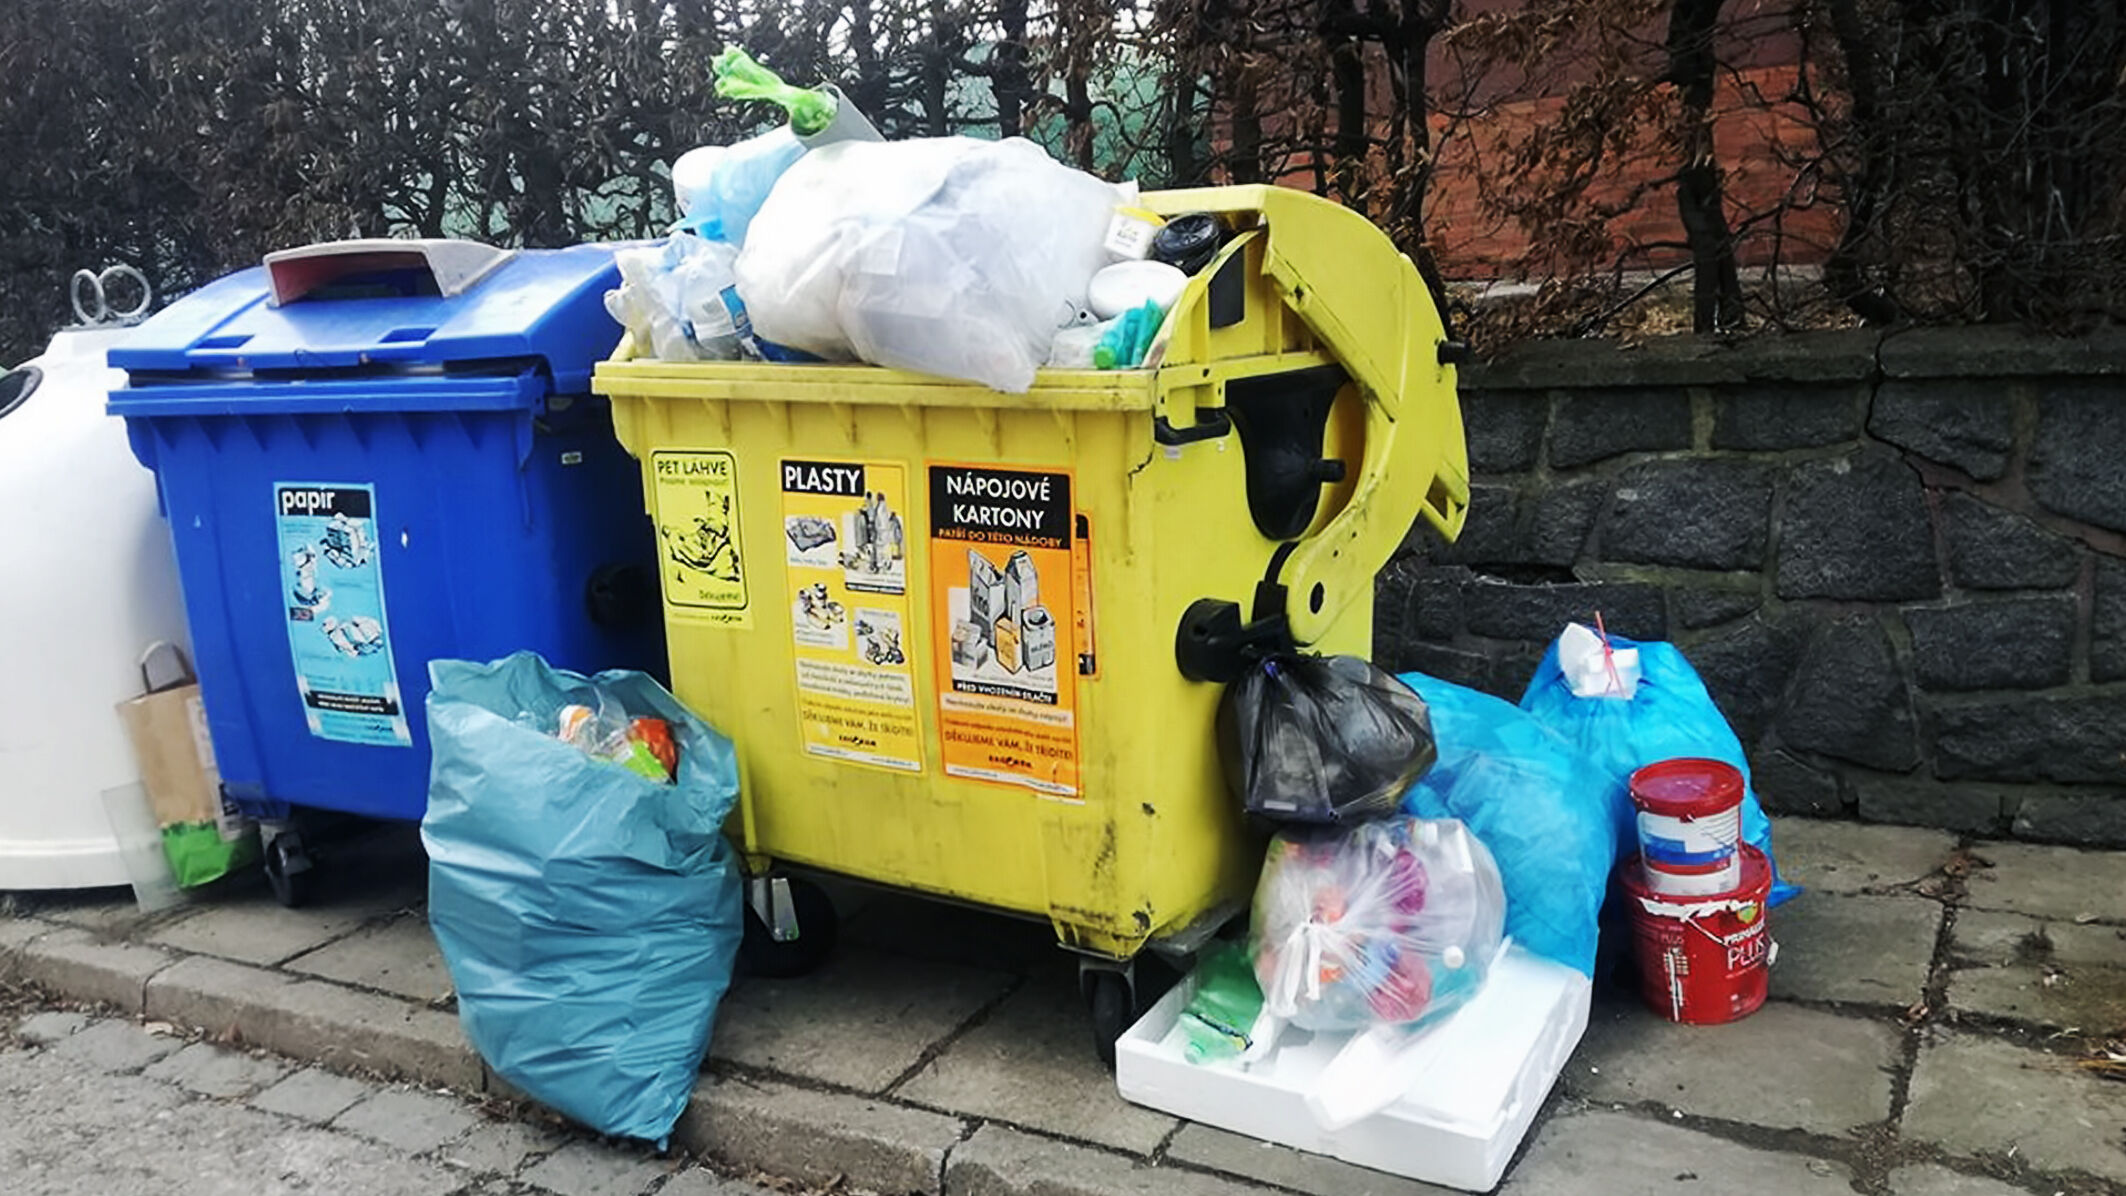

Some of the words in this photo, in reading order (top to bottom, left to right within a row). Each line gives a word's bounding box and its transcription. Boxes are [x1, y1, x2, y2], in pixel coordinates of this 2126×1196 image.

[658, 460, 679, 474] PET
[785, 466, 861, 493] PLASTY
[947, 472, 1051, 501] NÁPOJOVÉ
[953, 504, 1044, 529] KARTONY
